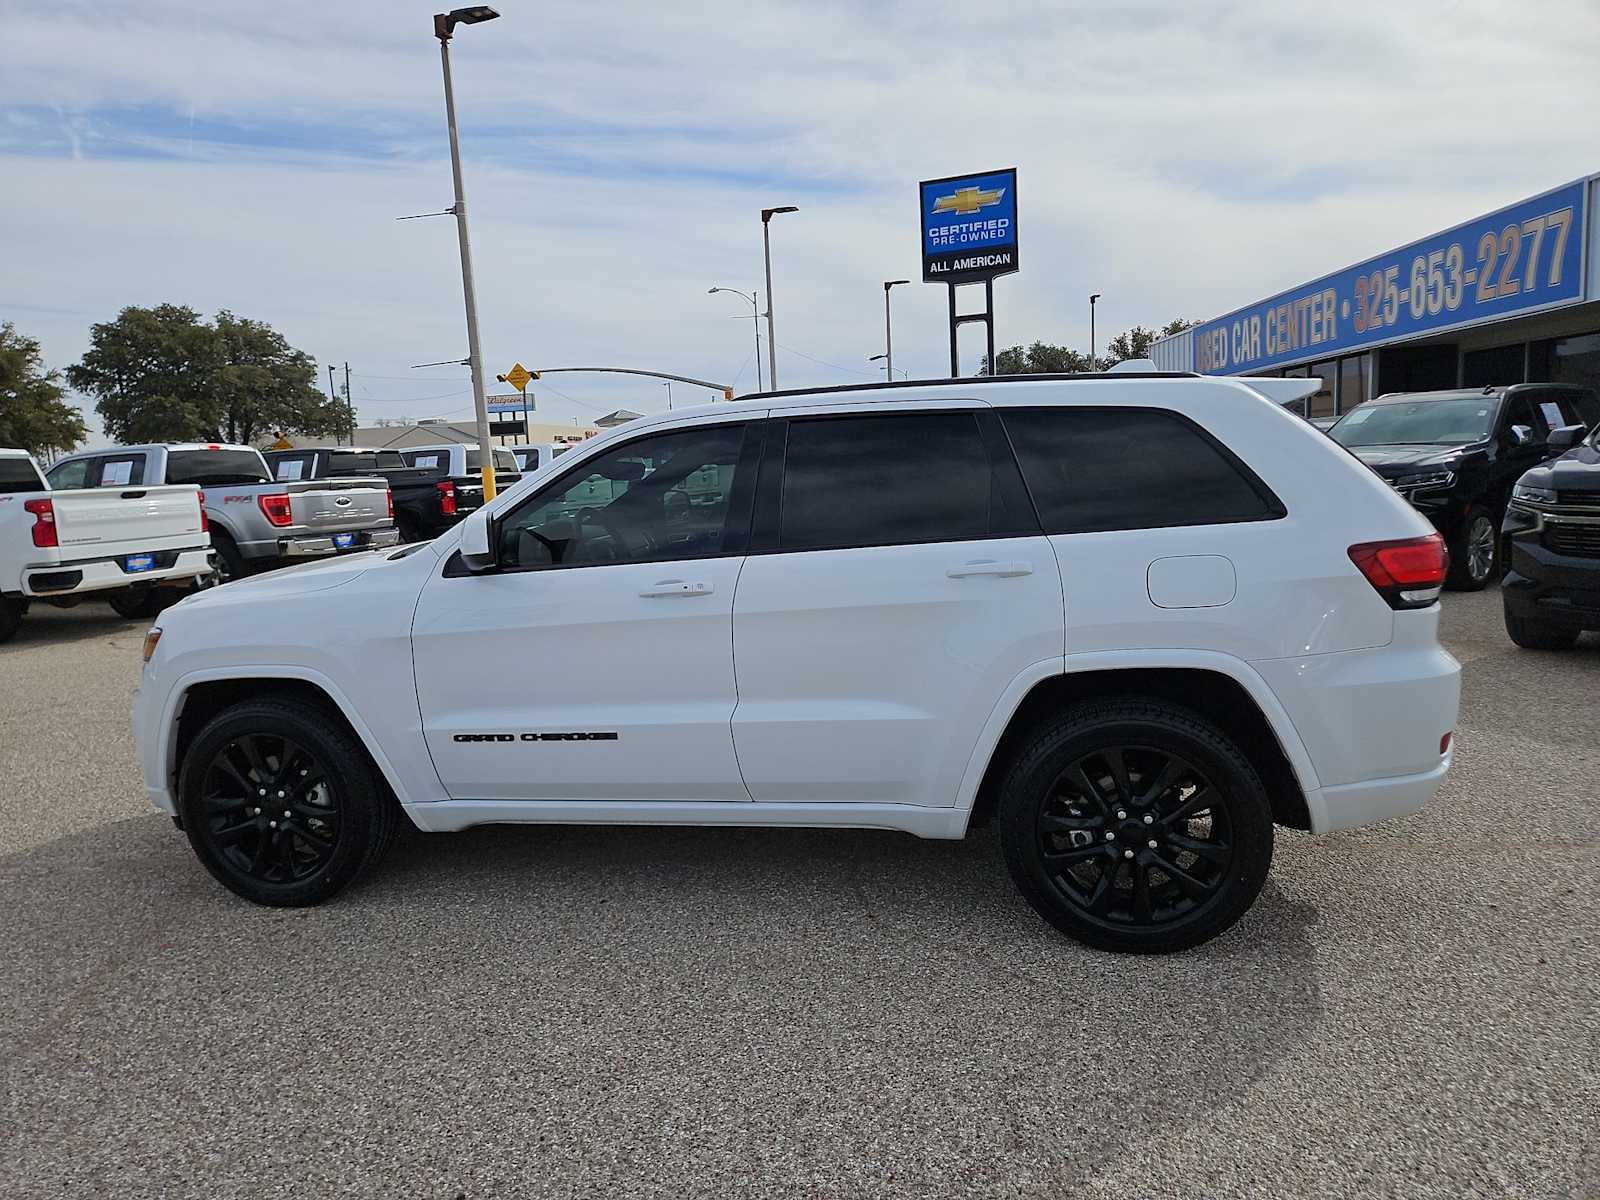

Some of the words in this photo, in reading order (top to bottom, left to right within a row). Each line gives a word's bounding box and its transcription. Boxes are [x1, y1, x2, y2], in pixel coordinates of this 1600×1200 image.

[928, 218, 1009, 238] CERTIFIED
[932, 229, 1006, 246] PRE-OWNED
[930, 261, 950, 273] ALL
[953, 253, 1011, 271] AMERICAN
[1195, 326, 1229, 373] USED
[1232, 314, 1261, 366] CAR
[1266, 288, 1337, 357] CENTER
[1354, 206, 1574, 334] 325-653-2277
[453, 734, 515, 742] GRAND
[520, 732, 618, 741] CHEROKEE
